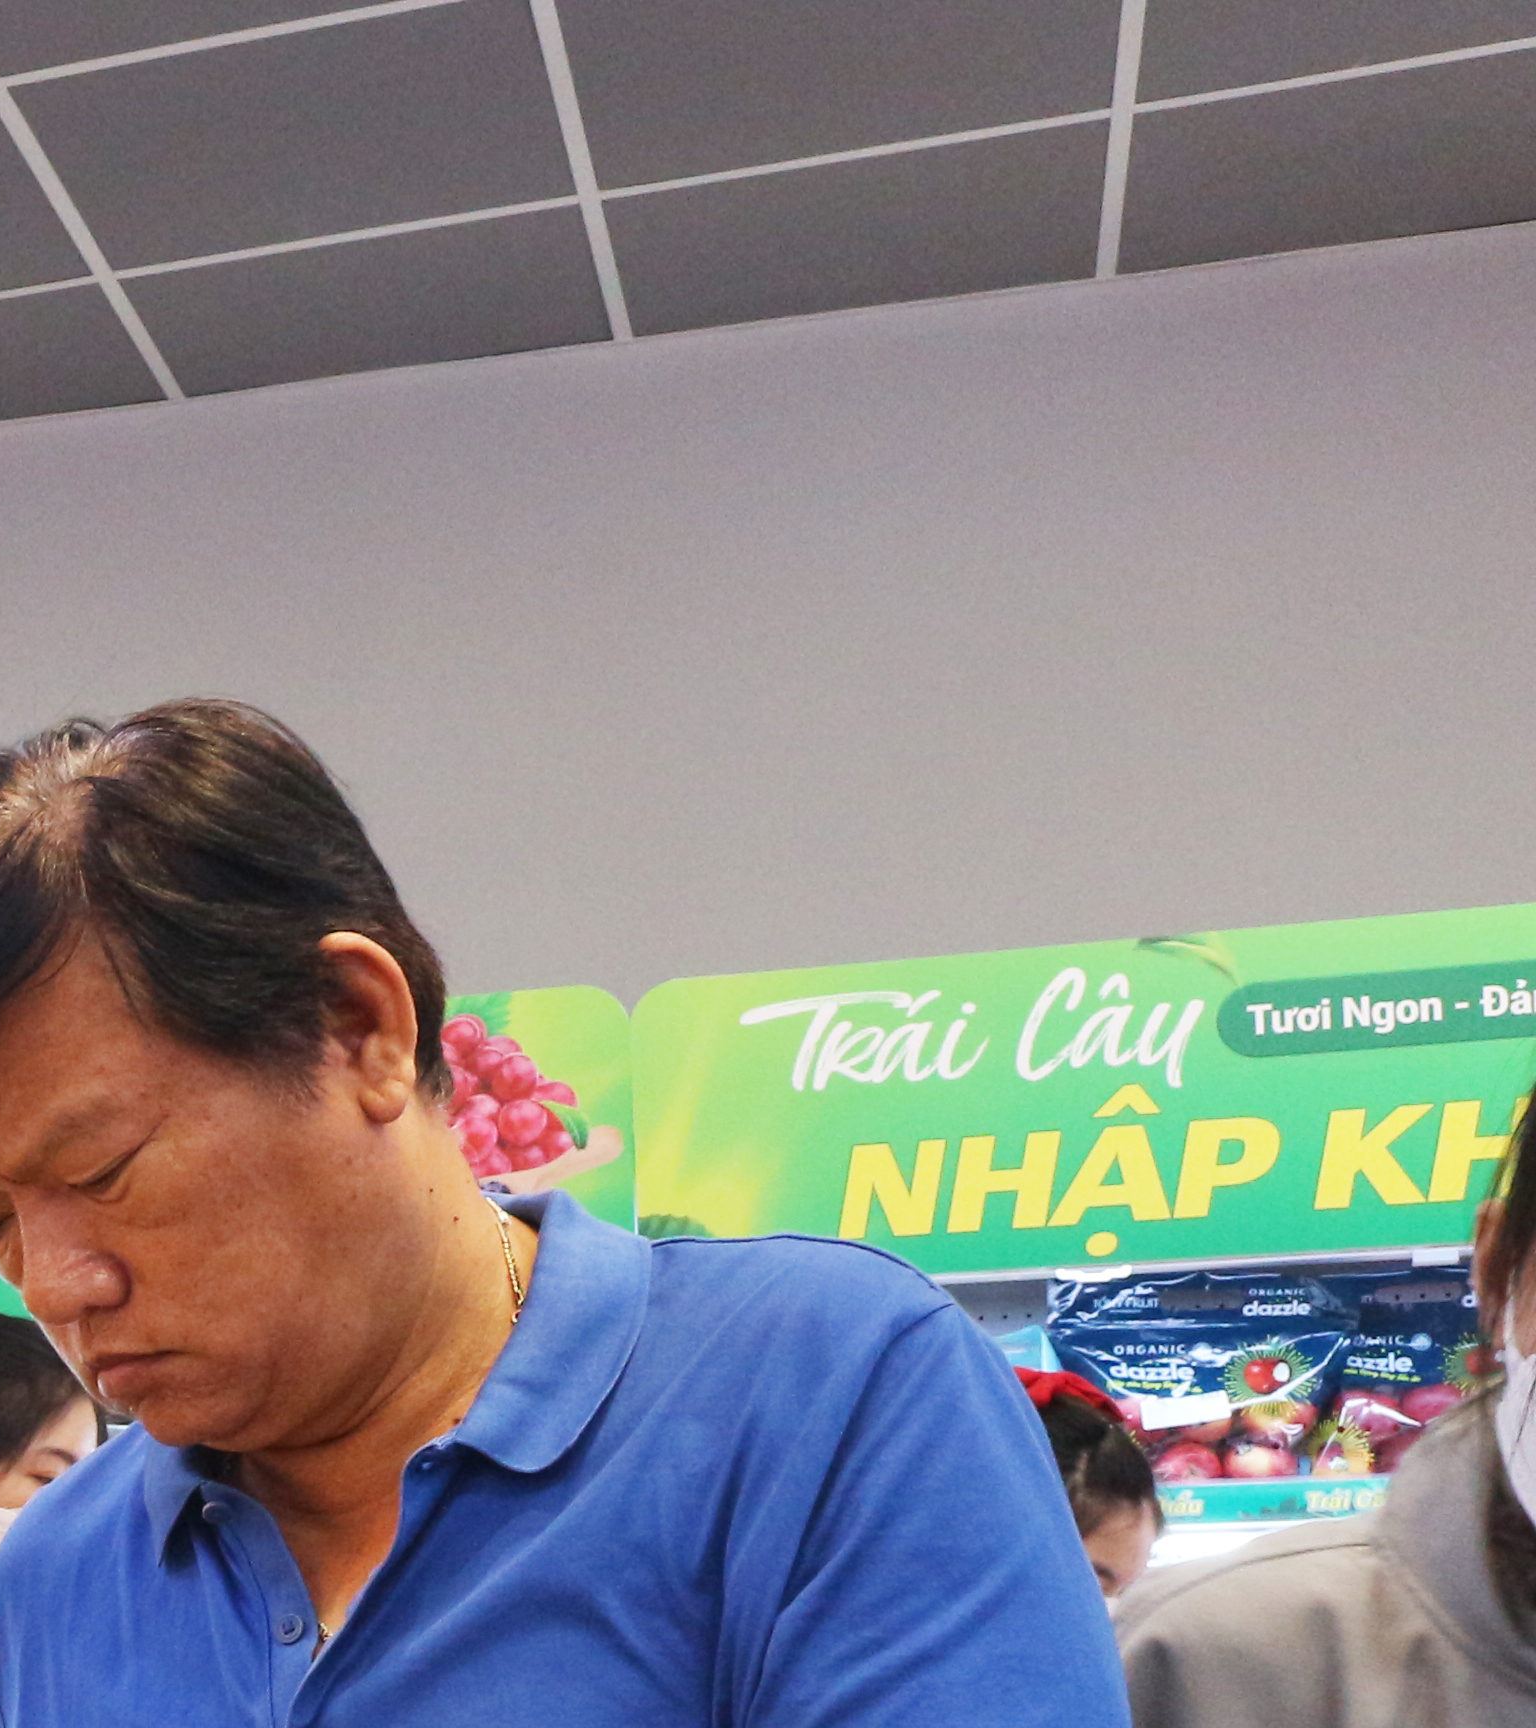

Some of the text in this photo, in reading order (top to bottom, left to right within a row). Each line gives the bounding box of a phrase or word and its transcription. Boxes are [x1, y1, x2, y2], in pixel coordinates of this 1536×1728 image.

[739, 988, 990, 1094] Trái
[1013, 967, 1204, 1089] Cây
[1246, 999, 1330, 1040] Tươi
[1341, 993, 1442, 1039] Ngon
[837, 1082, 1282, 1259] NHẬP
[1248, 1287, 1306, 1297] ORGANIC
[1242, 1298, 1312, 1318] dazzle
[1113, 1343, 1187, 1356] ORGANIC
[1109, 1361, 1196, 1382] dazzle
[1346, 1349, 1415, 1373] azzle
